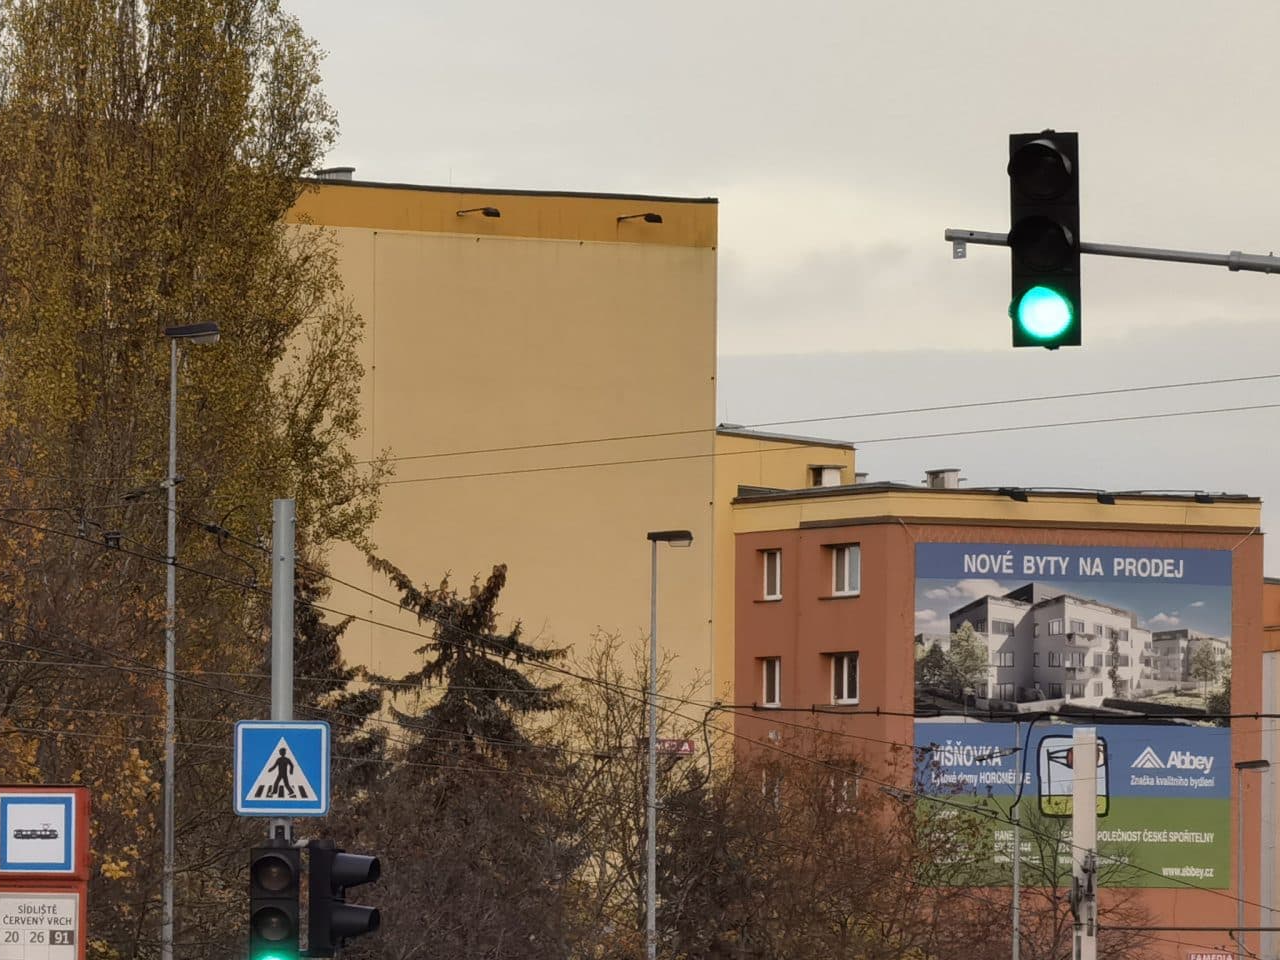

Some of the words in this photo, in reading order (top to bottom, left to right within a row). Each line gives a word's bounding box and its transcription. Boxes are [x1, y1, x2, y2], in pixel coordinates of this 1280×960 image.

[963, 550, 1014, 574] NOVÉ
[1023, 555, 1070, 576] BYTY
[1079, 557, 1105, 576] NA
[1113, 558, 1184, 578] PRODEJ
[1166, 751, 1214, 774] Abbey
[1096, 828, 1142, 842] POLEČNOST
[1143, 828, 1168, 842] ČESKÉ
[1169, 829, 1215, 843] SPOŘITELNY
[1162, 866, 1215, 880] www.abbey.cz
[18, 903, 57, 915] SÍDLIŠTĚ
[3, 914, 45, 926] ČERVENÝ
[47, 916, 72, 926] VRCH
[4, 931, 20, 943] 20
[29, 931, 45, 944] 26
[54, 931, 70, 945] 91
